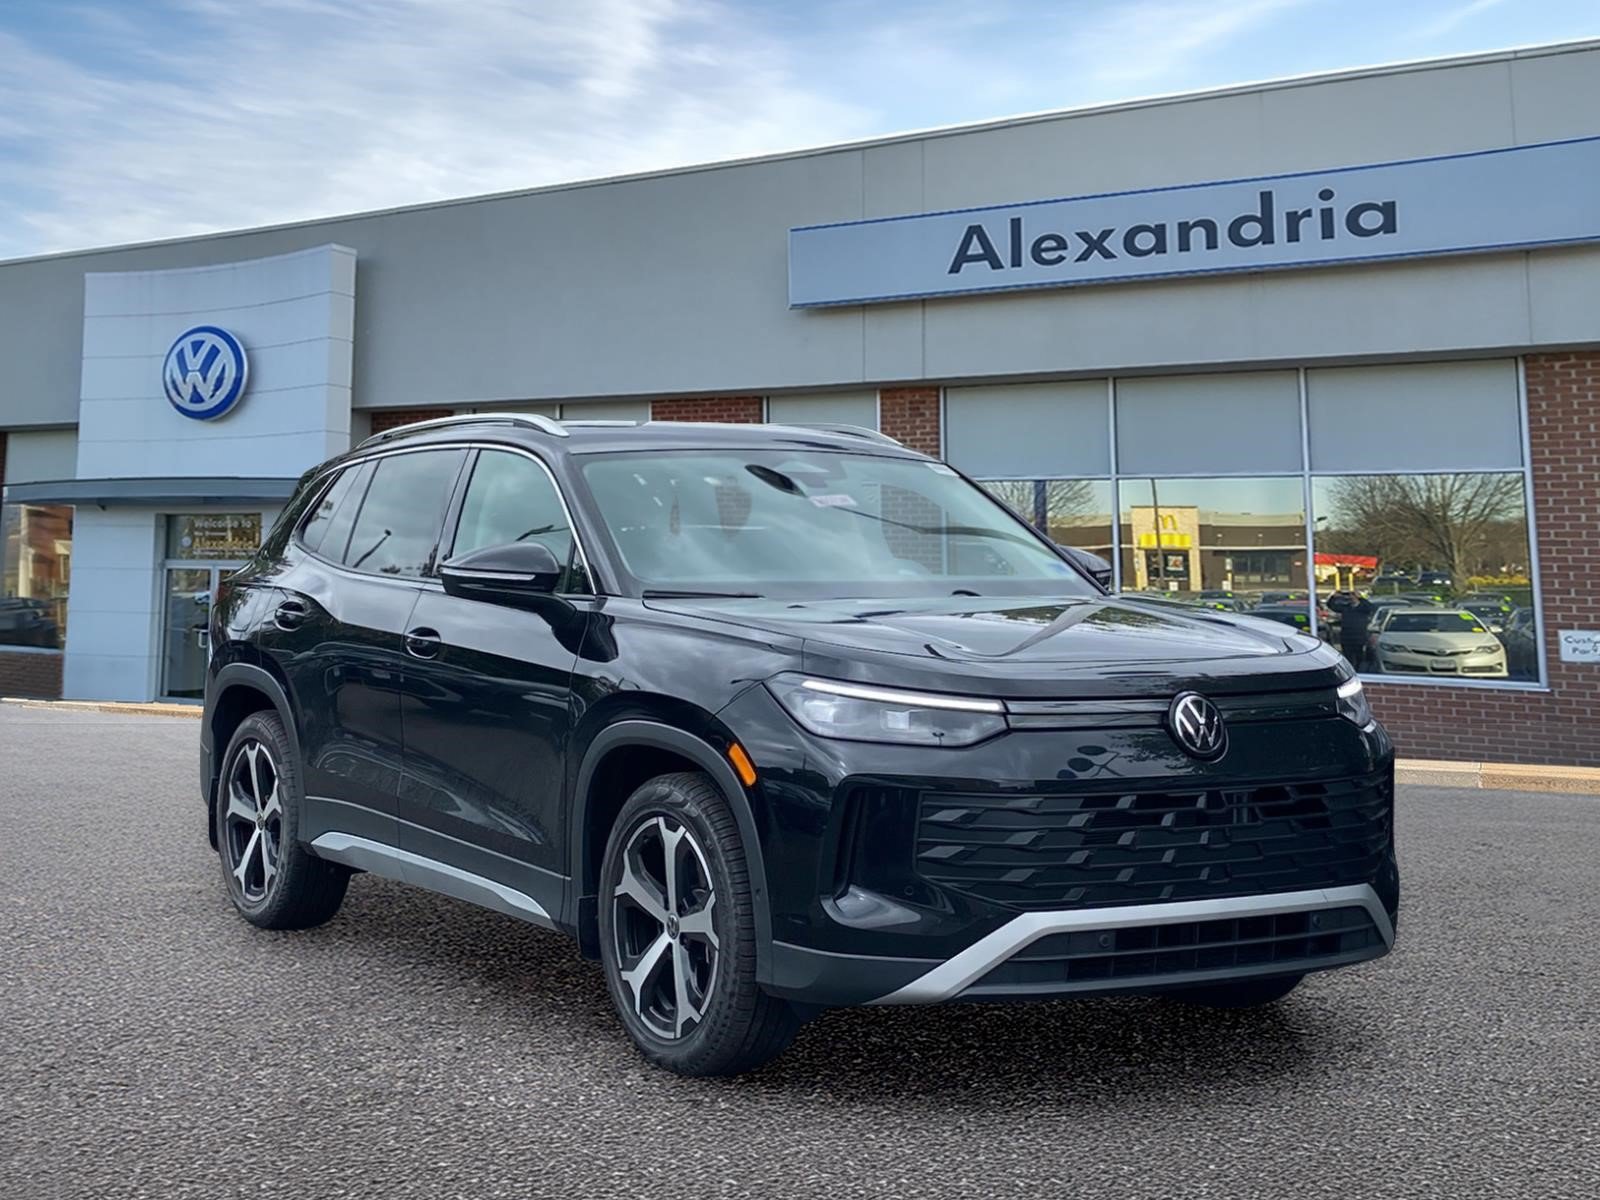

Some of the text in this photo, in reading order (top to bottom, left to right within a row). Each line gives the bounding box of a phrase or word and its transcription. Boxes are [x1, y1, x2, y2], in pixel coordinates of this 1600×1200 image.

[948, 188, 1398, 275] Alexandria
[166, 332, 237, 412] VW
[193, 519, 252, 528] Welcome to
[1175, 694, 1223, 753] VW
